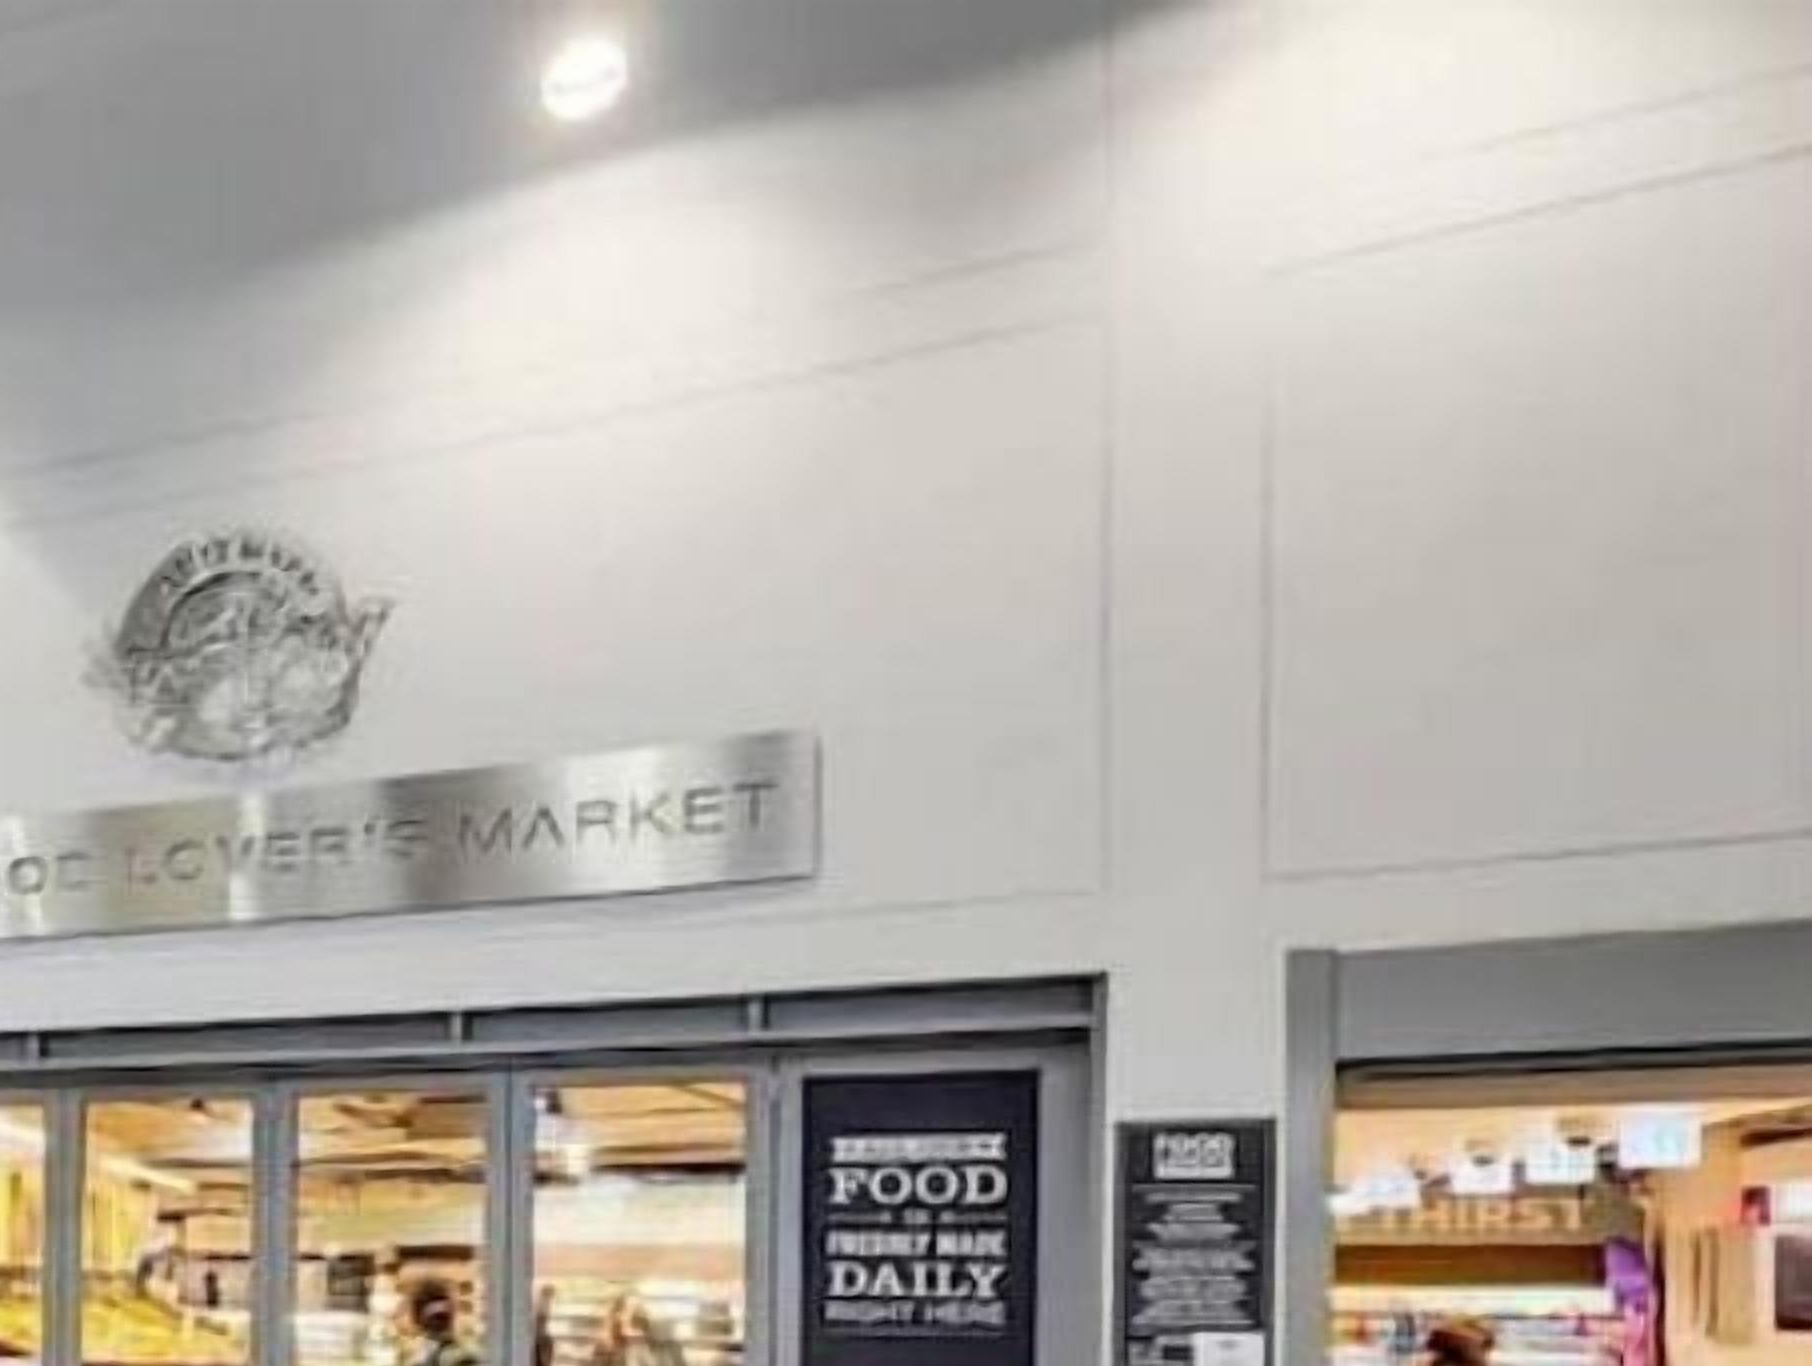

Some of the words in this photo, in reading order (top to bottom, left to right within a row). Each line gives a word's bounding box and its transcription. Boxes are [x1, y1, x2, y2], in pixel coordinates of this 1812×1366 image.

[458, 778, 781, 853] MARKET
[826, 1163, 1009, 1206] FOOD
[825, 1260, 1009, 1299] DAILY
